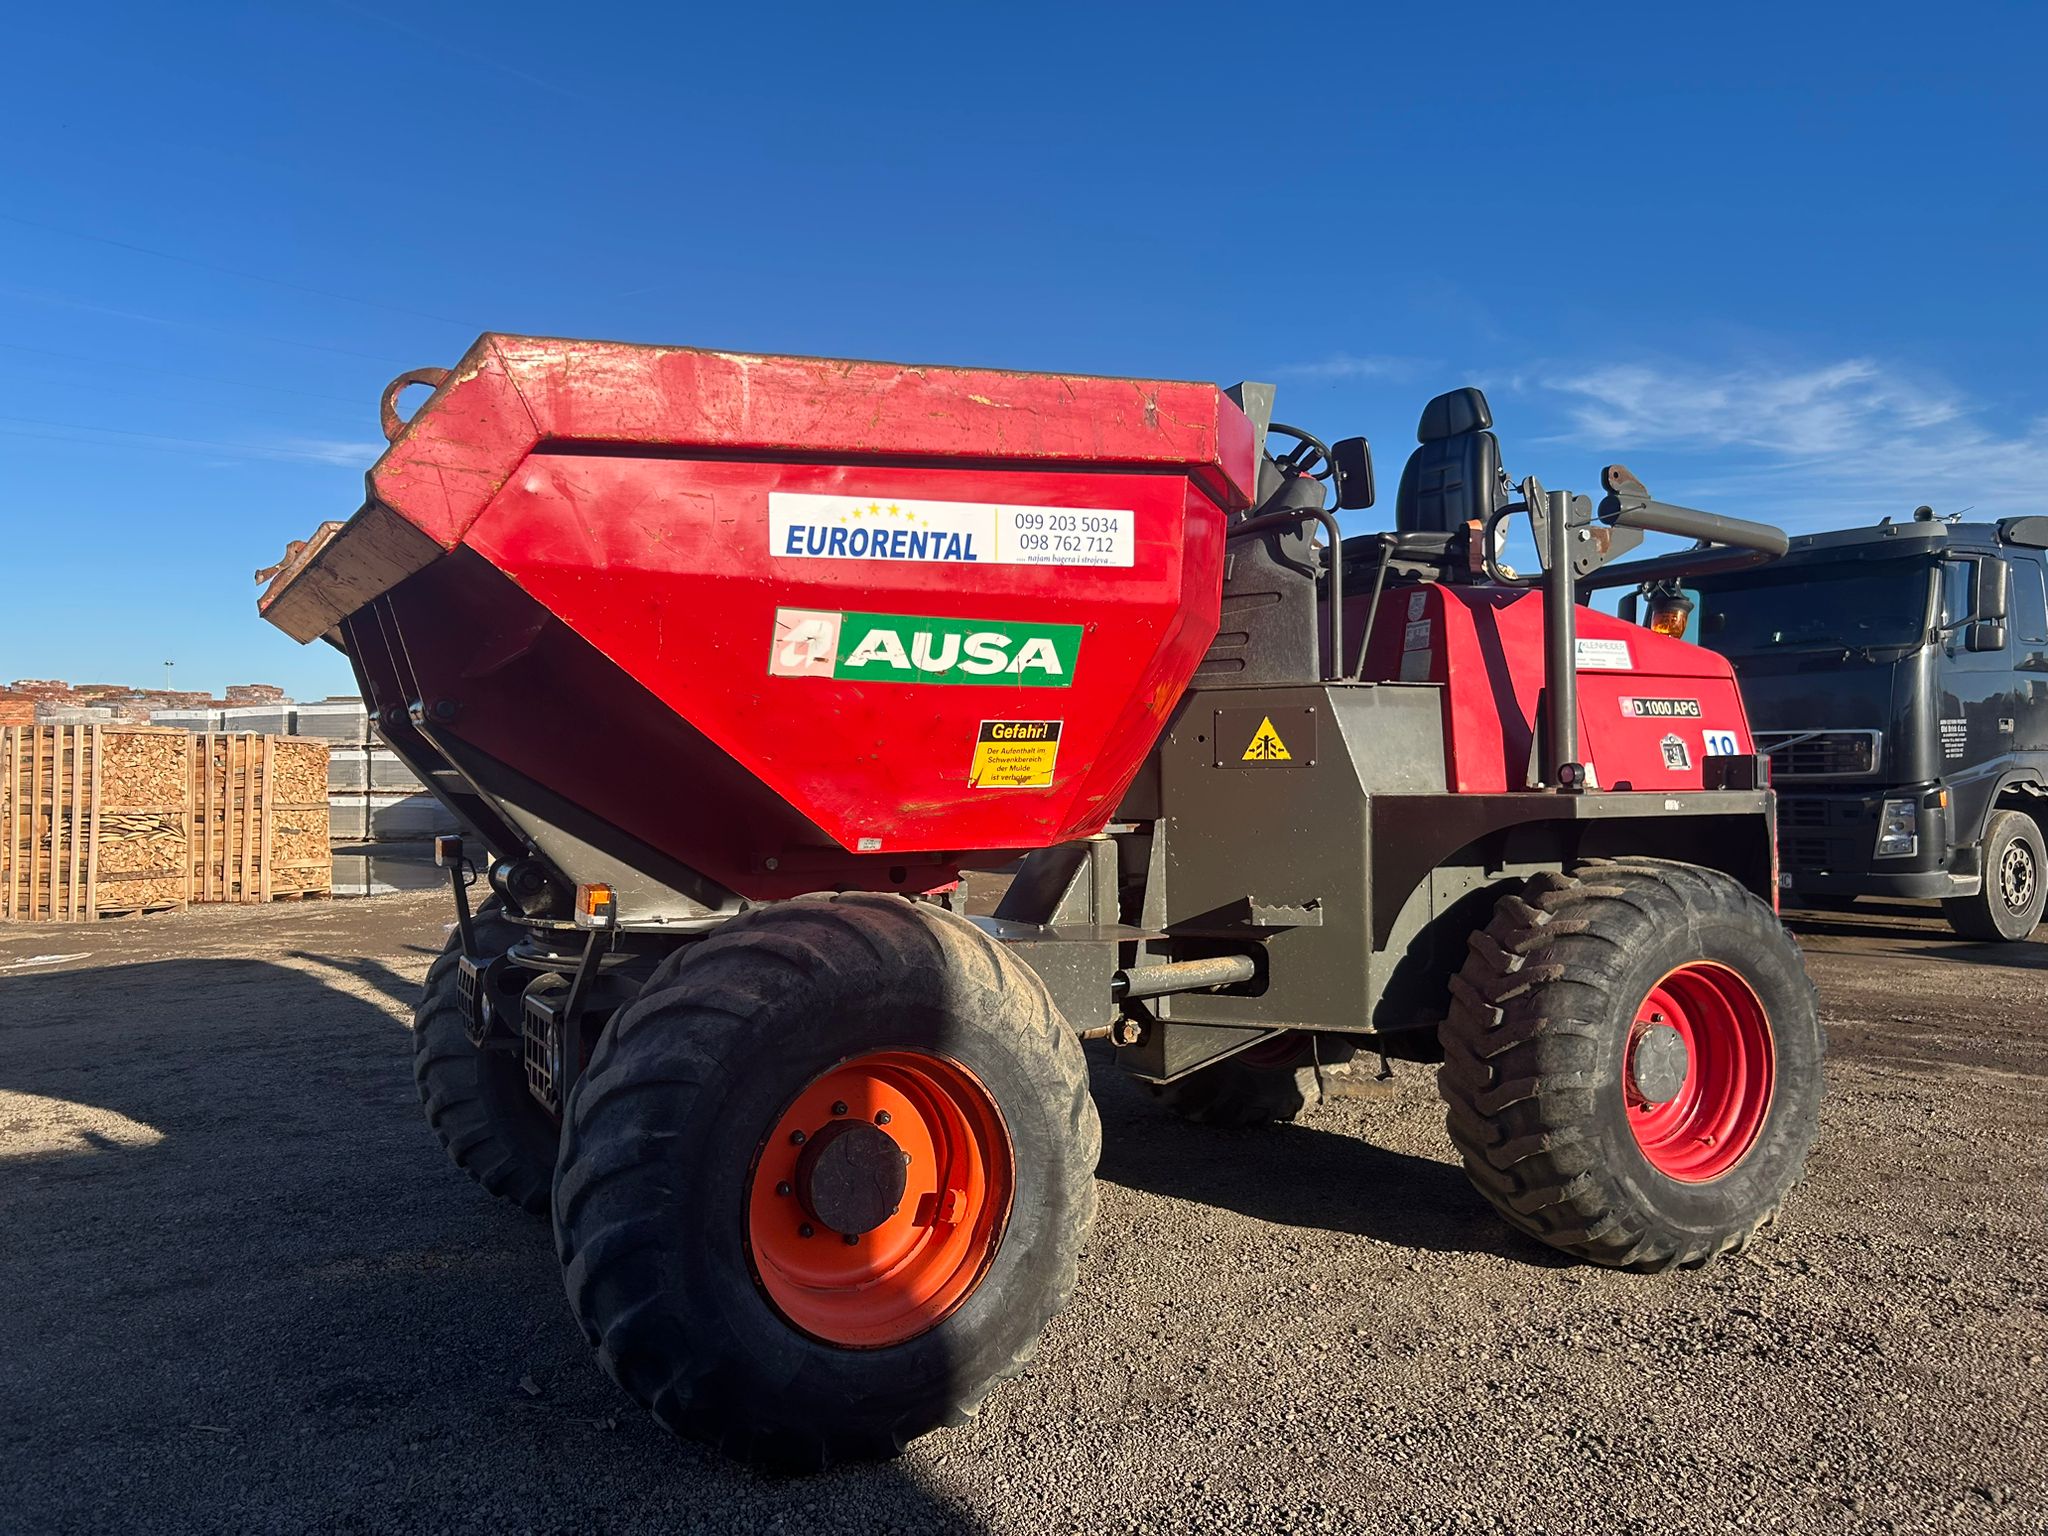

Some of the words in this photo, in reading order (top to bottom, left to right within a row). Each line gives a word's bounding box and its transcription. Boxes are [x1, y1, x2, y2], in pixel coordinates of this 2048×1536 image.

[1015, 513, 1044, 530] 099
[1048, 515, 1077, 531] 203
[1081, 517, 1118, 533] 5034
[786, 525, 978, 561] EURORENTAL
[1020, 534, 1049, 550] 098
[1053, 535, 1081, 552] 762
[1086, 536, 1113, 553] 712
[1027, 555, 1051, 565] najam
[1052, 554, 1076, 566] bagera
[1081, 555, 1108, 566] strojeva
[843, 629, 1064, 676] AUSA
[1633, 700, 1644, 714] D
[1645, 700, 1672, 715] 1000
[1673, 701, 1699, 716] APG
[992, 723, 1048, 738] Gefahr!
[987, 747, 1000, 755] Der
[1001, 747, 1036, 755] Aufenthalt
